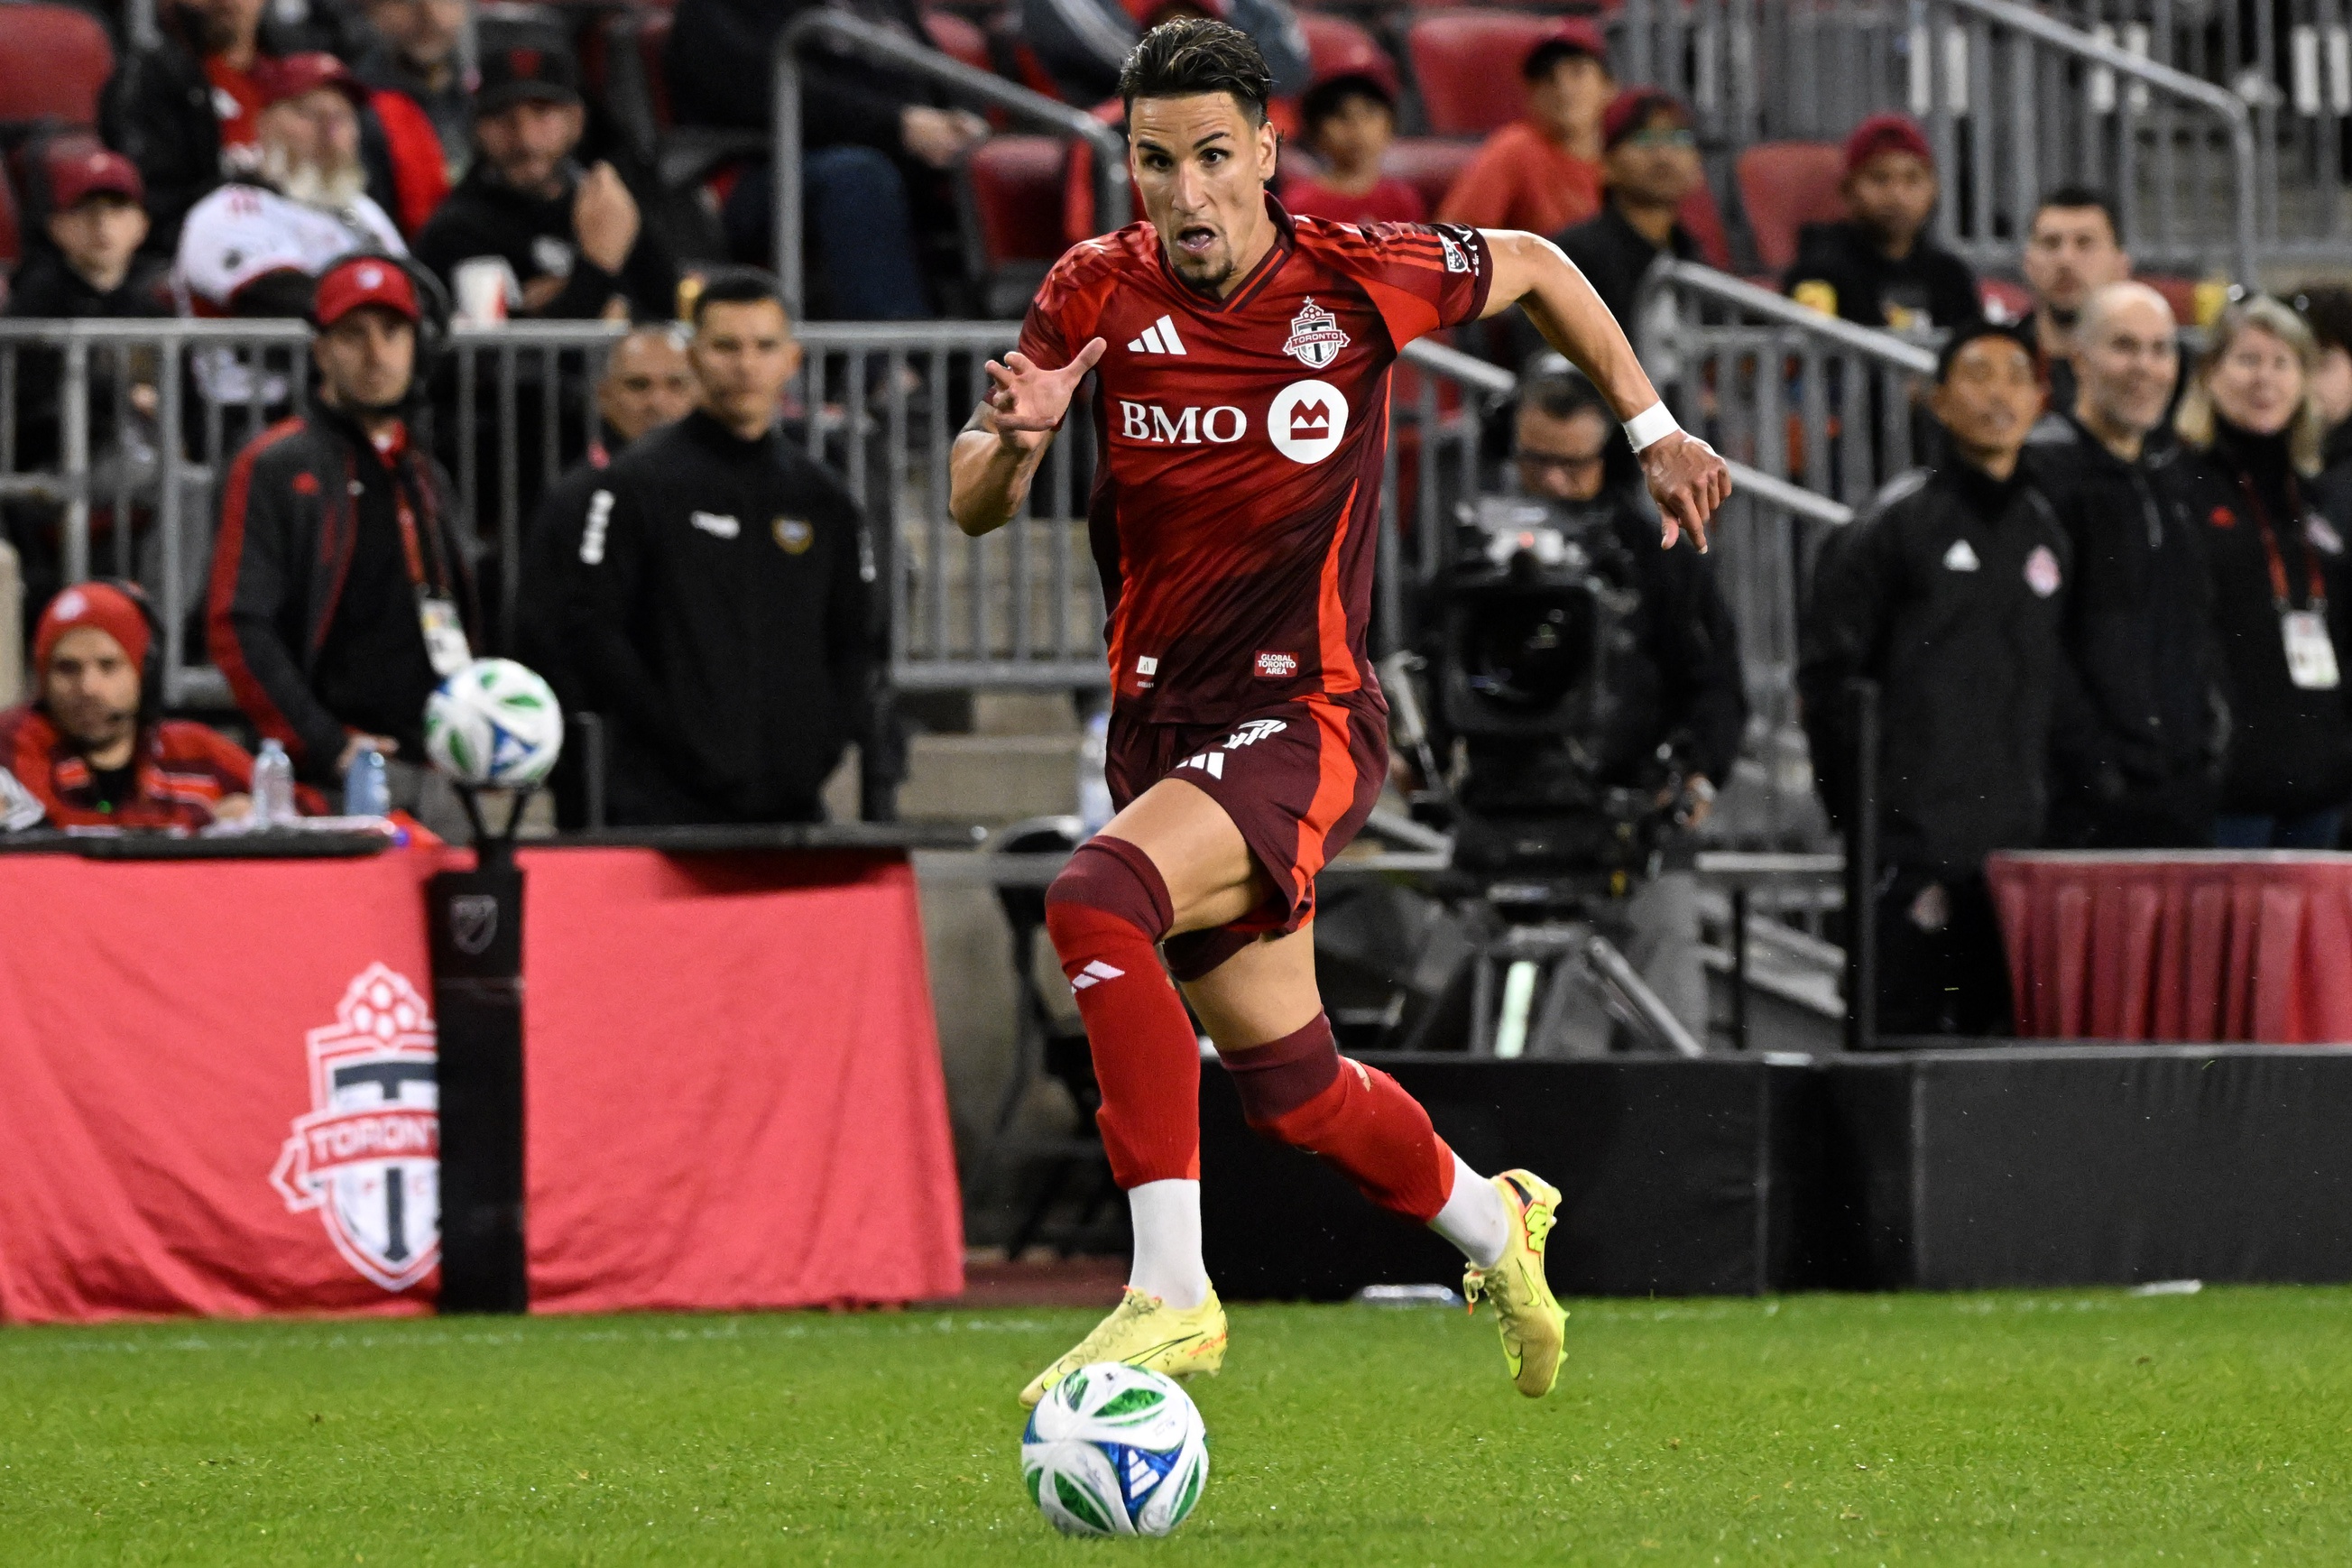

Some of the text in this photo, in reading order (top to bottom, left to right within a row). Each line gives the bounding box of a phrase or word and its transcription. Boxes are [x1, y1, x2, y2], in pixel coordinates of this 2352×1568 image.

[1292, 332, 1339, 345] TORONTO
[1120, 401, 1248, 444] BMO
[1260, 653, 1294, 662] GLOBAL
[1258, 659, 1296, 669] TORONTO
[1265, 667, 1287, 675] AREA
[312, 1116, 439, 1161] TORON
